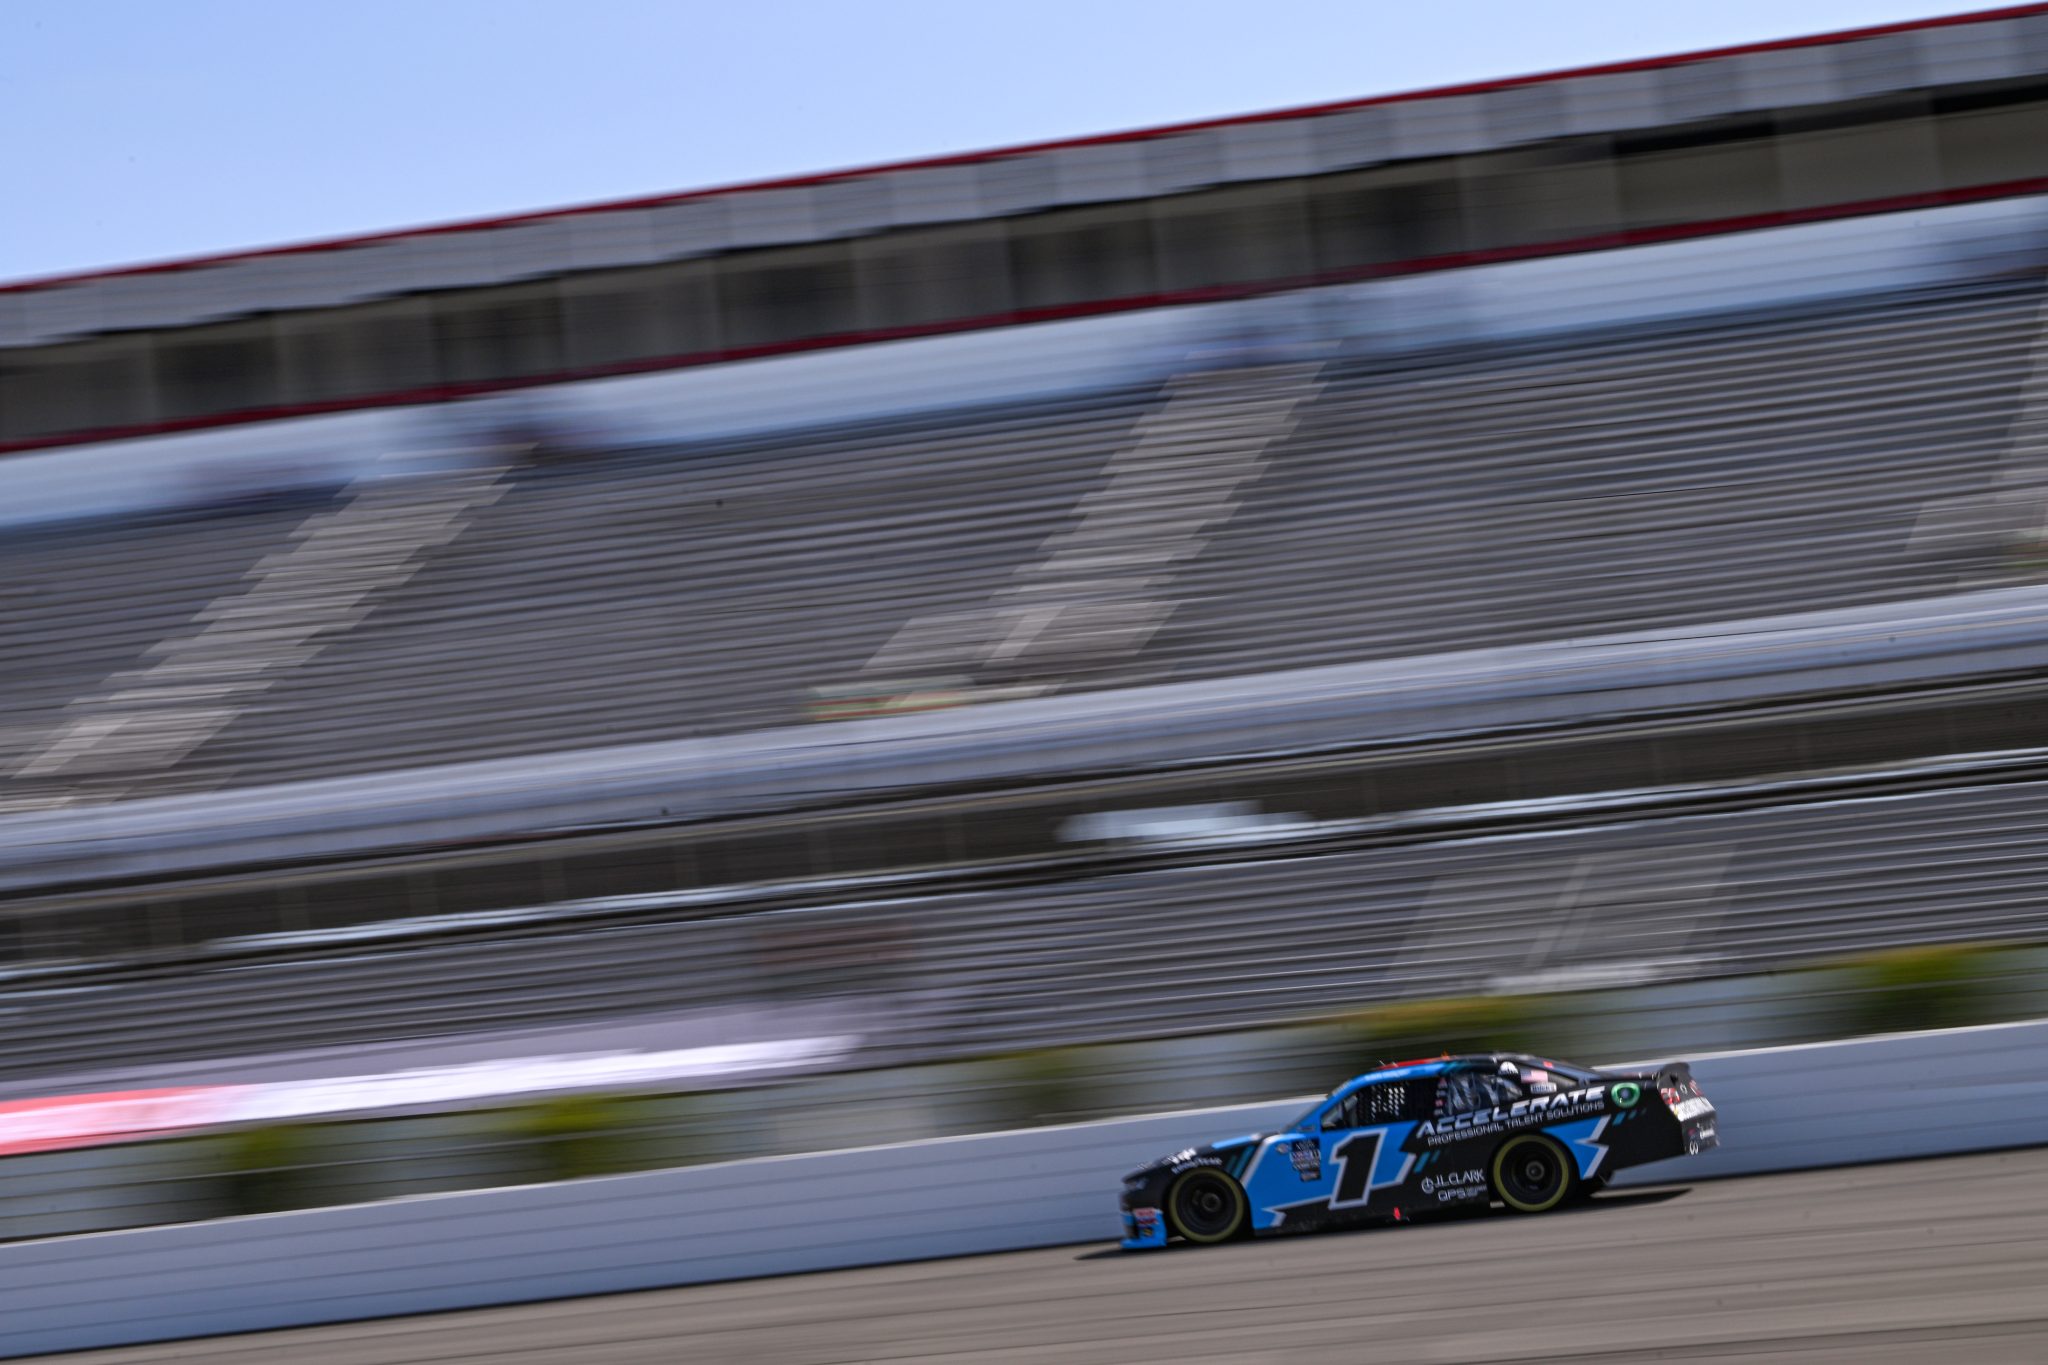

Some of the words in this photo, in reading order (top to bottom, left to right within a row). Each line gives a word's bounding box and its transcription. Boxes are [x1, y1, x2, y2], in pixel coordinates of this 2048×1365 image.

[1416, 1086, 1606, 1138] ACCELERATE
[1427, 1122, 1504, 1147] PROFESSIONAL
[1505, 1111, 1543, 1128] TALENT
[1546, 1100, 1605, 1120] SOLUTIONS
[1328, 1127, 1388, 1211] 1
